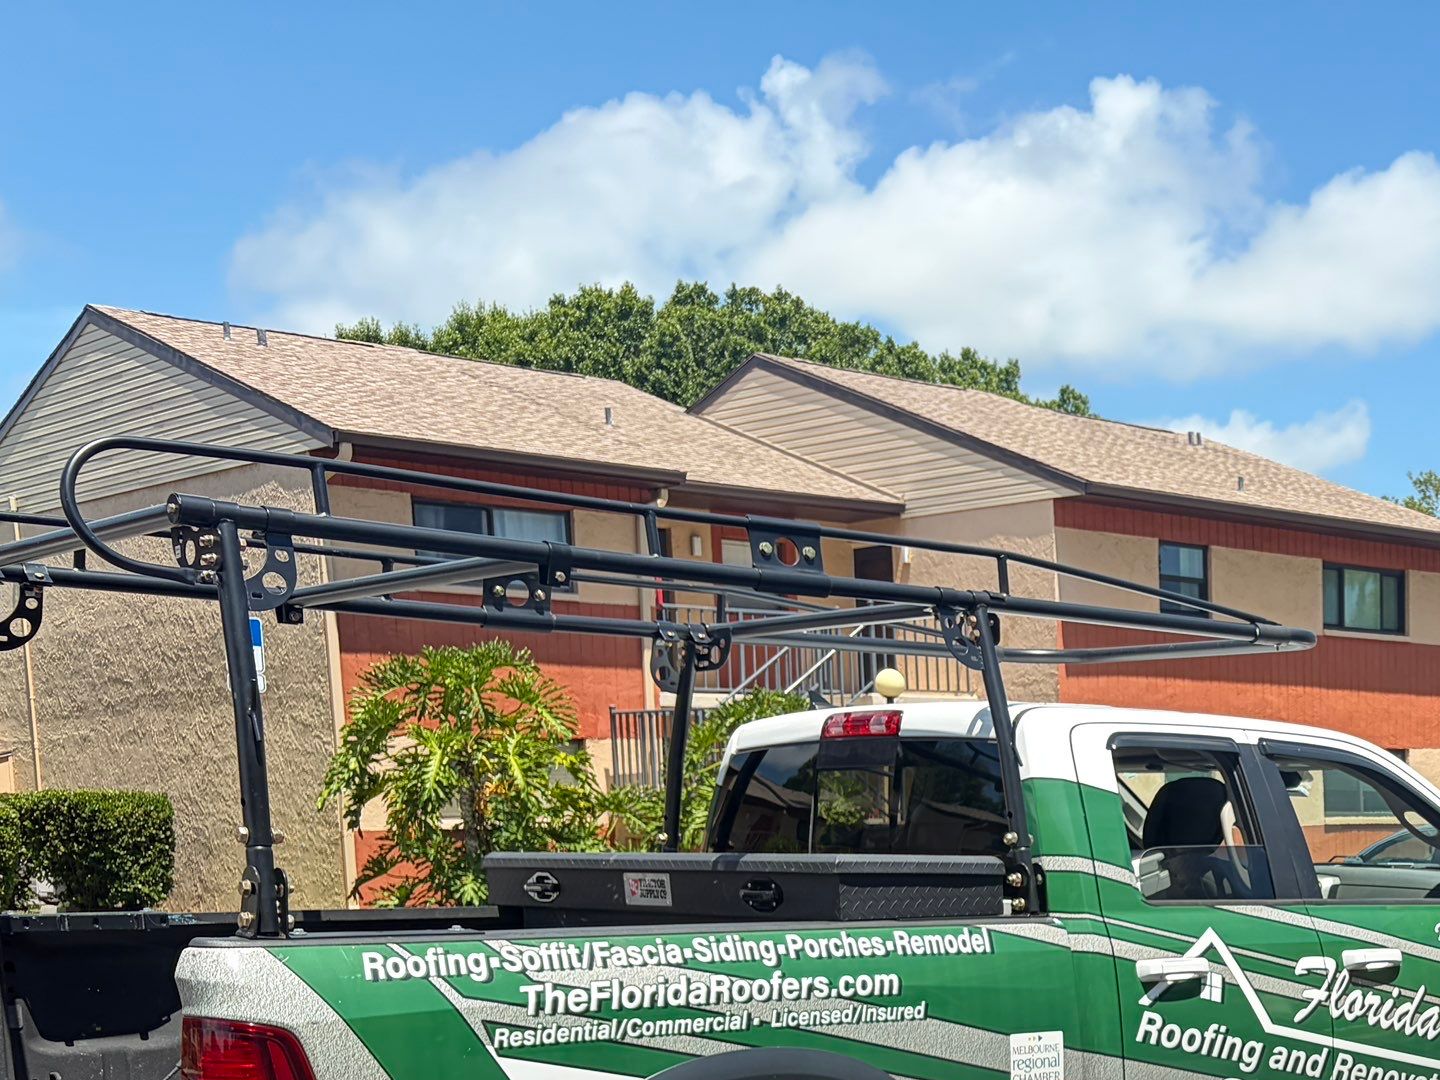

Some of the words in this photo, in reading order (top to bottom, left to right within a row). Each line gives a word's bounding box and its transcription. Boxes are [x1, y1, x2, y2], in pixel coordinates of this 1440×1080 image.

[640, 889, 659, 899] SUPPLY
[361, 948, 490, 983] Roofing
[501, 938, 683, 973] Soffit/Fascia
[692, 934, 777, 967] Siding
[786, 931, 886, 959] Porches
[894, 927, 992, 955] Remodel
[519, 970, 900, 1016] TheFloridaRoofers.com
[494, 1009, 748, 1048] Residential/Commercial
[770, 1001, 926, 1028] Licensed/Insured
[1135, 1010, 1265, 1072] Roofing
[1268, 1045, 1331, 1078] and
[1012, 1043, 1060, 1055] MELBOURNE
[1013, 1053, 1060, 1073] regional
